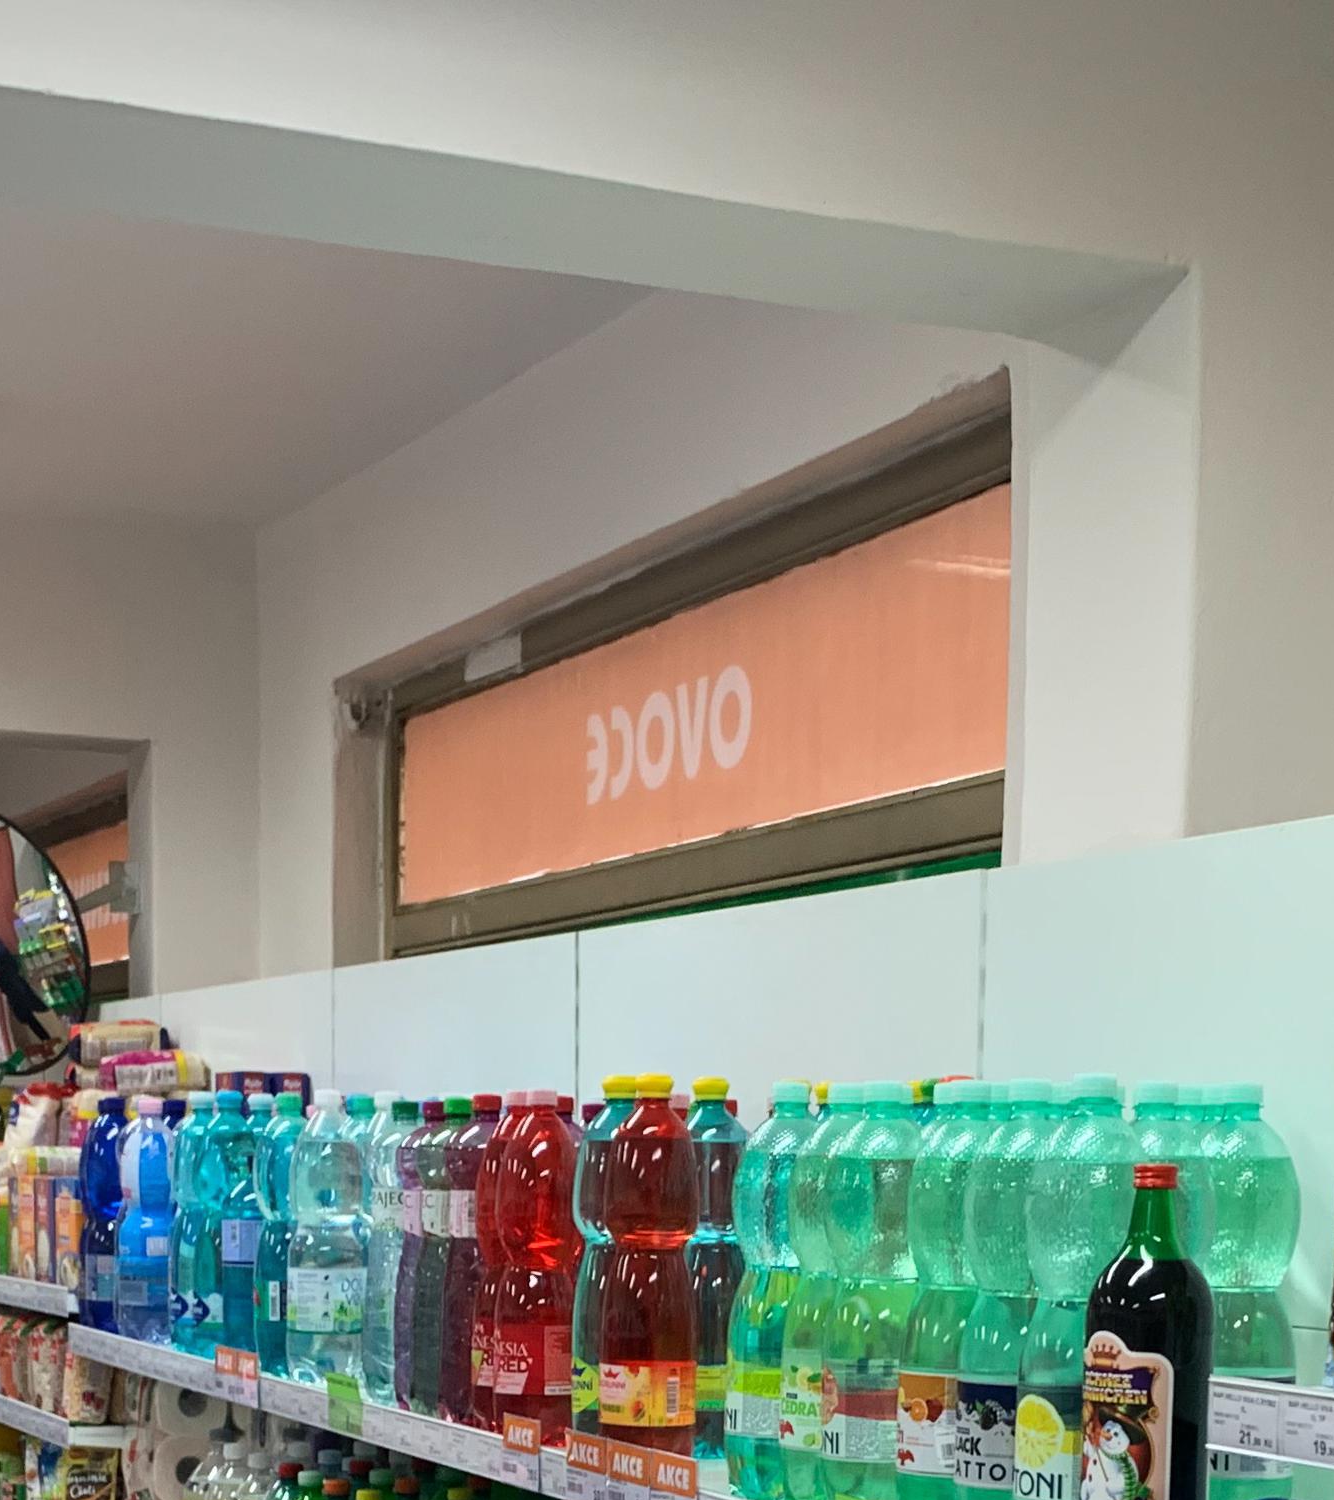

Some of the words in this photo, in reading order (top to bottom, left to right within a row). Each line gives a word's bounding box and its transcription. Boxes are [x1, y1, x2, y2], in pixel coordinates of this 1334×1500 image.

[506, 1424, 535, 1449] AKCE
[568, 1442, 601, 1468] AKCE
[611, 1452, 644, 1480] AKCE
[656, 1463, 690, 1491] AKCE
[1013, 1467, 1063, 1500] TONI
